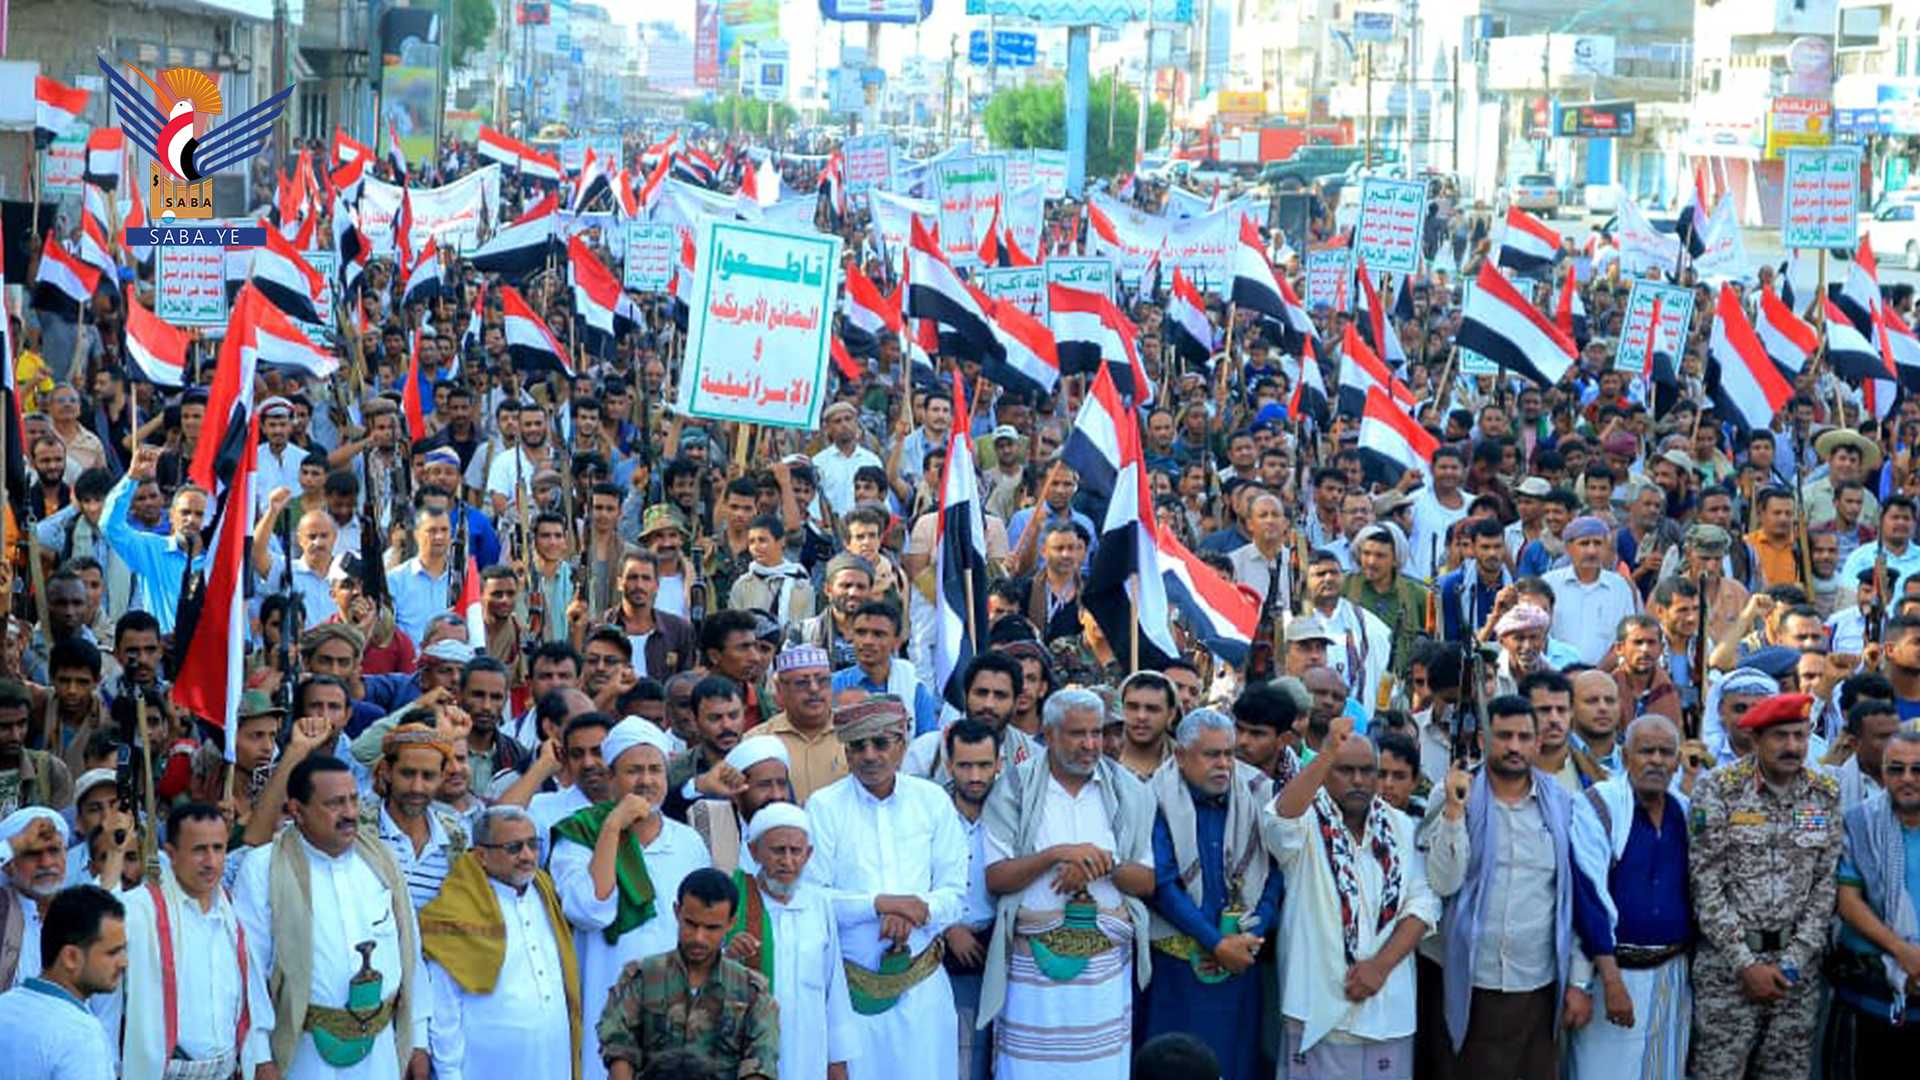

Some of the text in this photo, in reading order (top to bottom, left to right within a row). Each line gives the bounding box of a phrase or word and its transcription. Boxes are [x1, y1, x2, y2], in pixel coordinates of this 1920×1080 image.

[716, 241, 823, 287] قاطعوا
[709, 289, 820, 334] البضائع الأمريكية
[753, 336, 763, 362] و
[701, 366, 811, 410] الإسرائيلية
